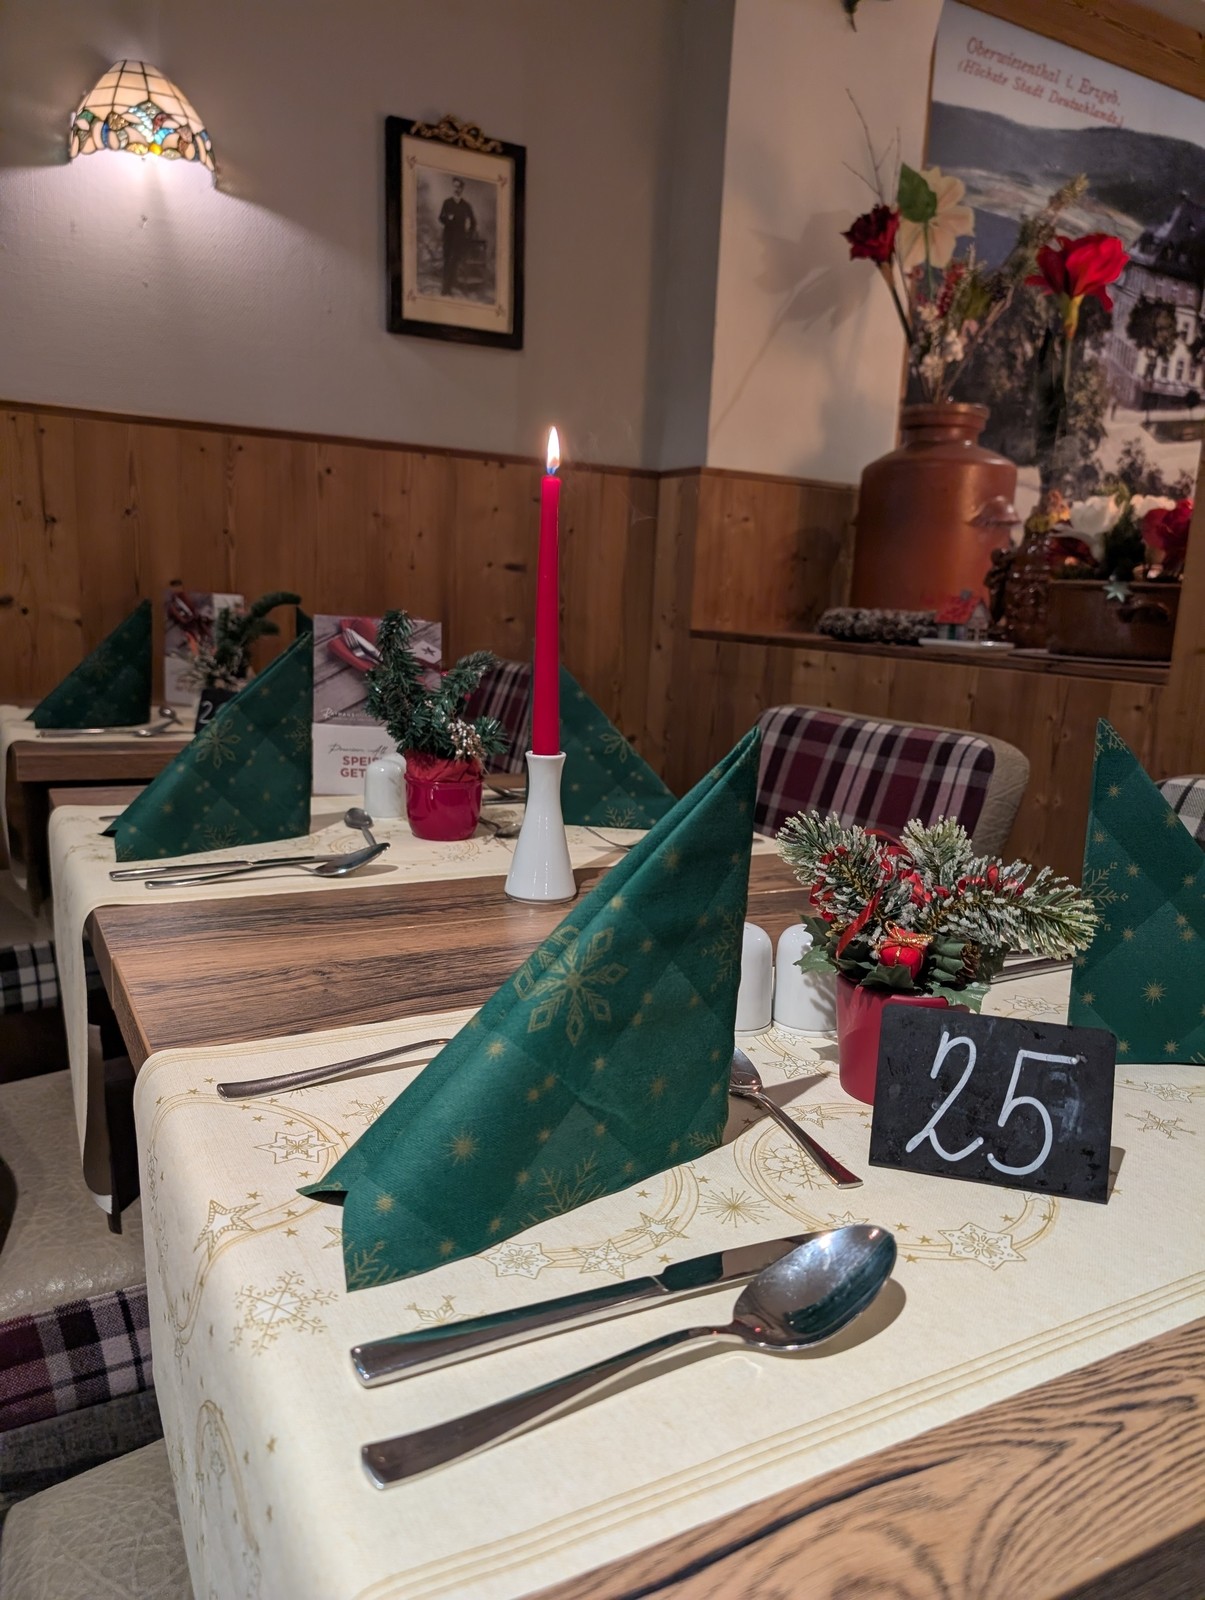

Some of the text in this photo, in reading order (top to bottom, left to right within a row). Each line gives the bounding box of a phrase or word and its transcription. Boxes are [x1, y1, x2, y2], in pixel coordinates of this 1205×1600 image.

[966, 36, 1062, 84] Oberwiesenthal
[1012, 77, 1045, 99] Stadt
[342, 756, 382, 767] SPEI
[340, 768, 366, 779] GET
[905, 1031, 1078, 1176] 25
